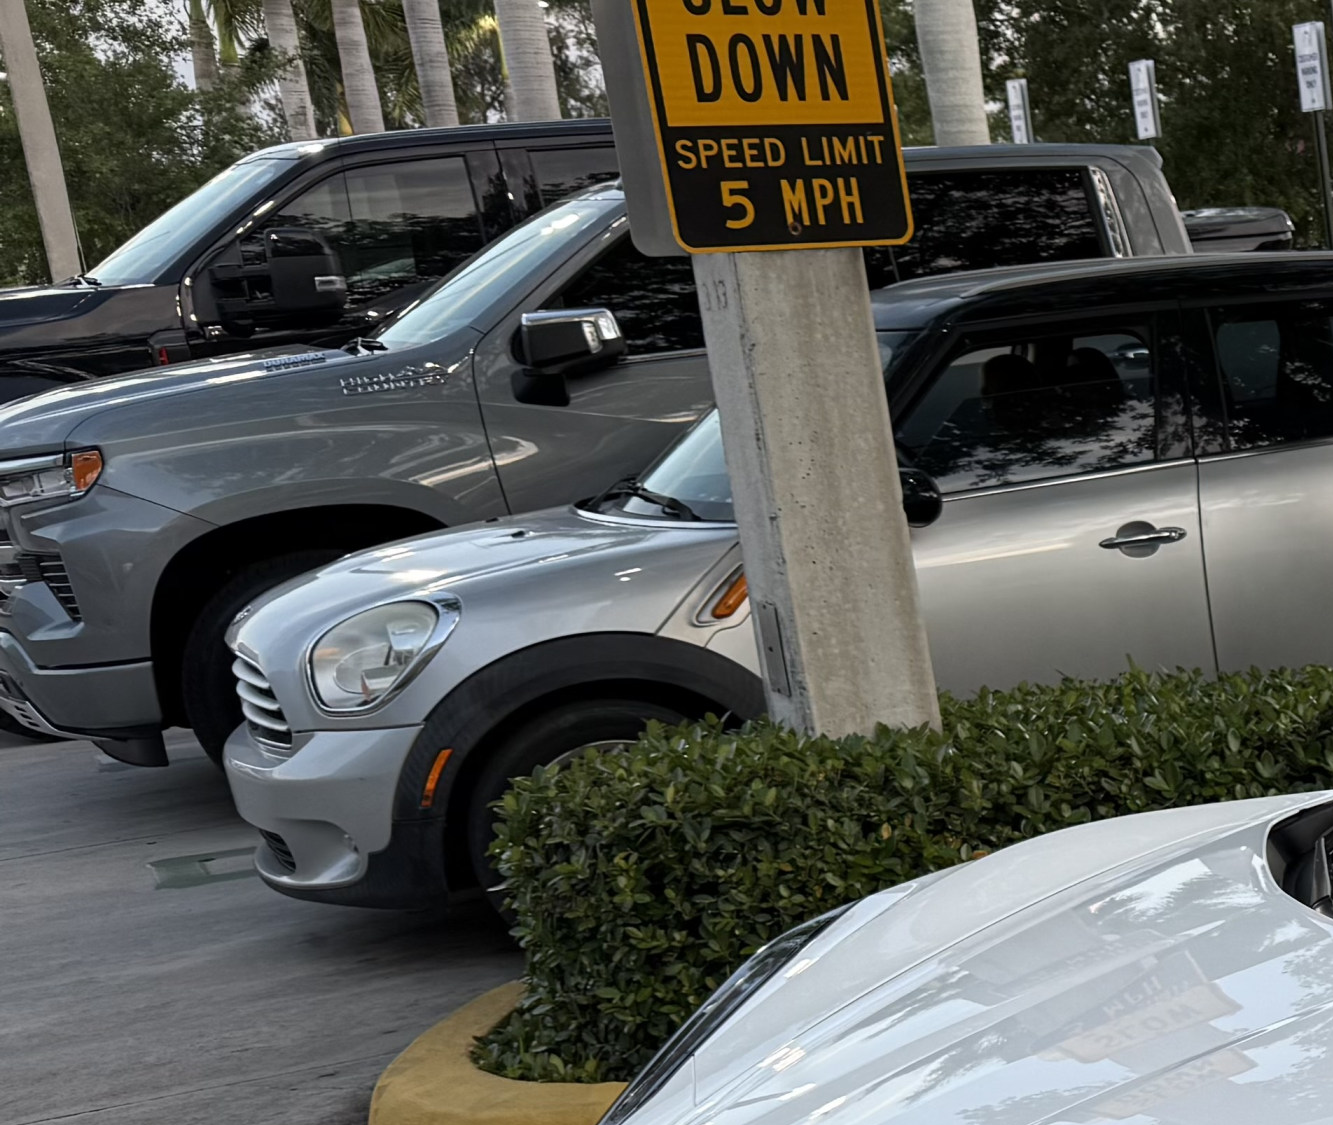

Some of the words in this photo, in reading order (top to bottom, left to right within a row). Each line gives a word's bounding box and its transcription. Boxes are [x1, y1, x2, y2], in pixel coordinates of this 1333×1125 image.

[686, 33, 849, 102] DOWN
[675, 138, 786, 169] SPEED
[801, 136, 884, 166] LIMIT
[720, 180, 755, 229] 5
[780, 177, 864, 226] MPH
